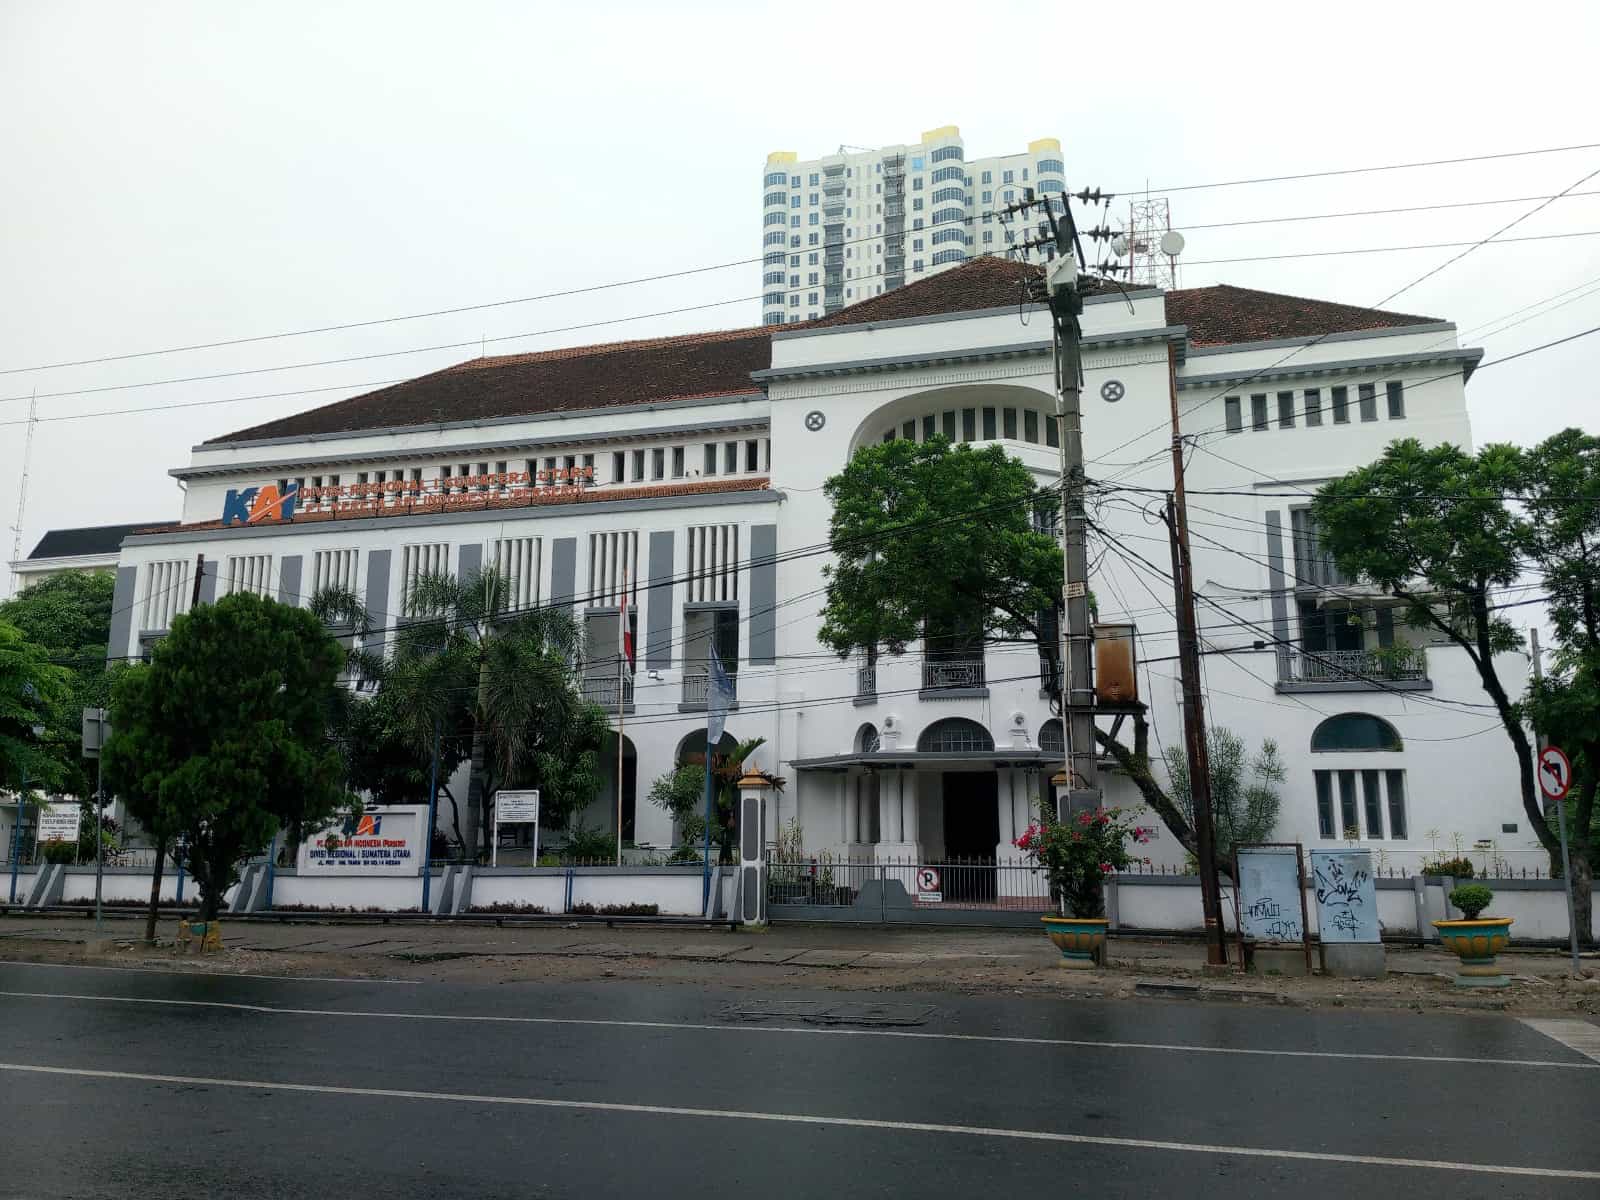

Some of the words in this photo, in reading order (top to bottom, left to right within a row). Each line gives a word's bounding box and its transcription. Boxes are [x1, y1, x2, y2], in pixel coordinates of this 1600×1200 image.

[299, 485, 344, 499] DIVISI
[350, 479, 426, 495] REGIONAL
[445, 471, 532, 487] SUMATERA
[538, 465, 593, 482] UTARA
[223, 482, 298, 525] KAI
[330, 498, 385, 512] KERETA
[394, 496, 417, 508] API
[424, 491, 500, 506] INDONESIA
[361, 849, 391, 858] SUMATERA
[392, 849, 411, 858] UTARA
